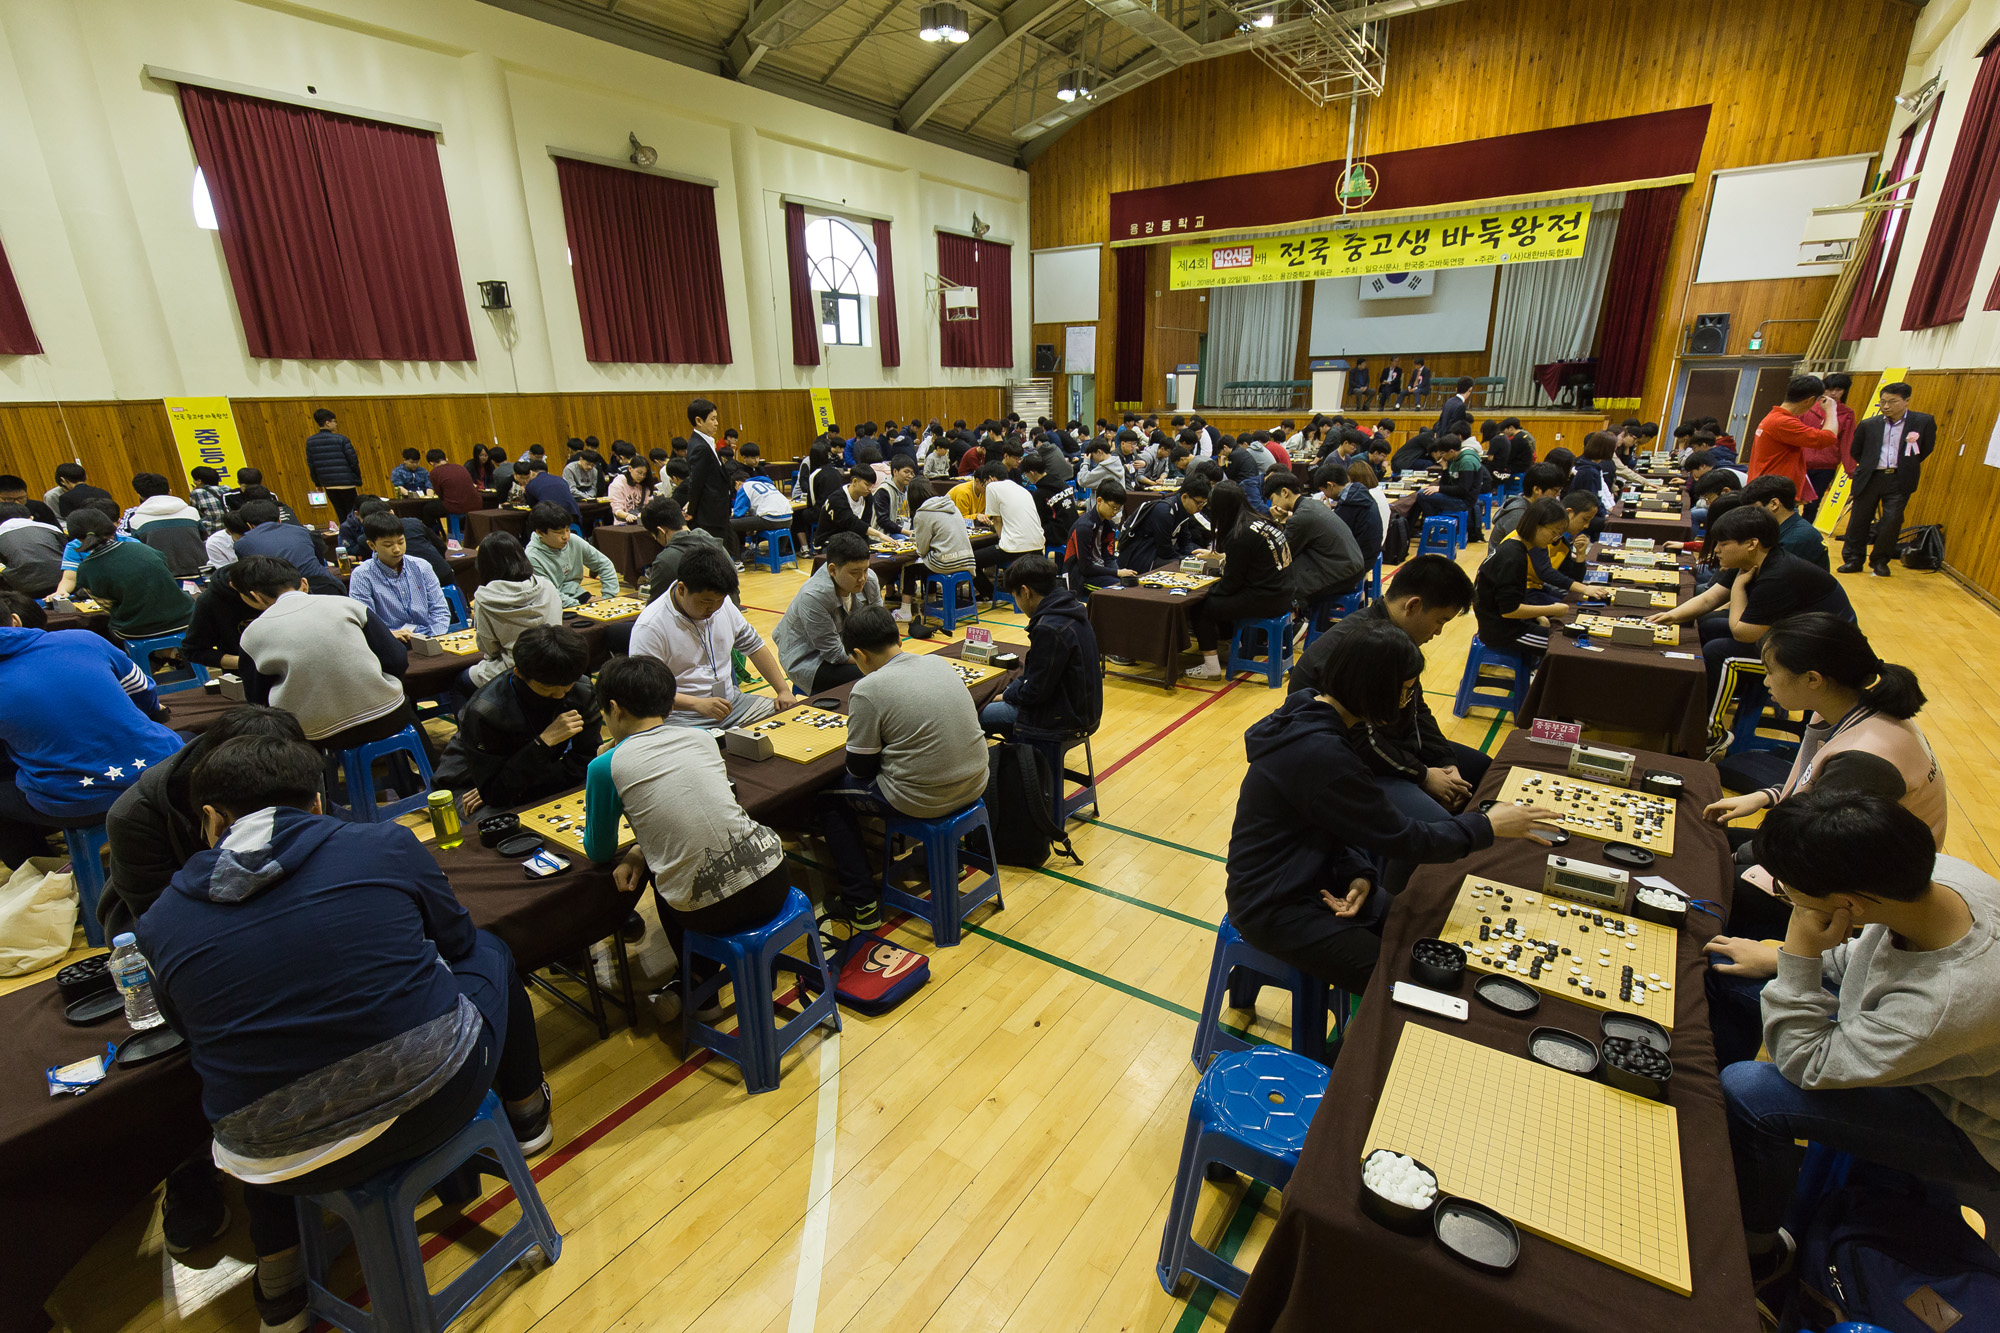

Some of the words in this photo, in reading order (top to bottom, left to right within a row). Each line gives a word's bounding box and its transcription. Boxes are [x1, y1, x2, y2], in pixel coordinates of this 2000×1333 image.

[1177, 257, 1208, 271] 제4회
[1213, 248, 1252, 268] 일요신문
[1280, 237, 1330, 267] 전국
[1343, 228, 1431, 262] 중고생
[1442, 211, 1582, 249] 바둑왕전
[1536, 720, 1576, 734] 중등부갑조
[1544, 731, 1565, 740] 17조
